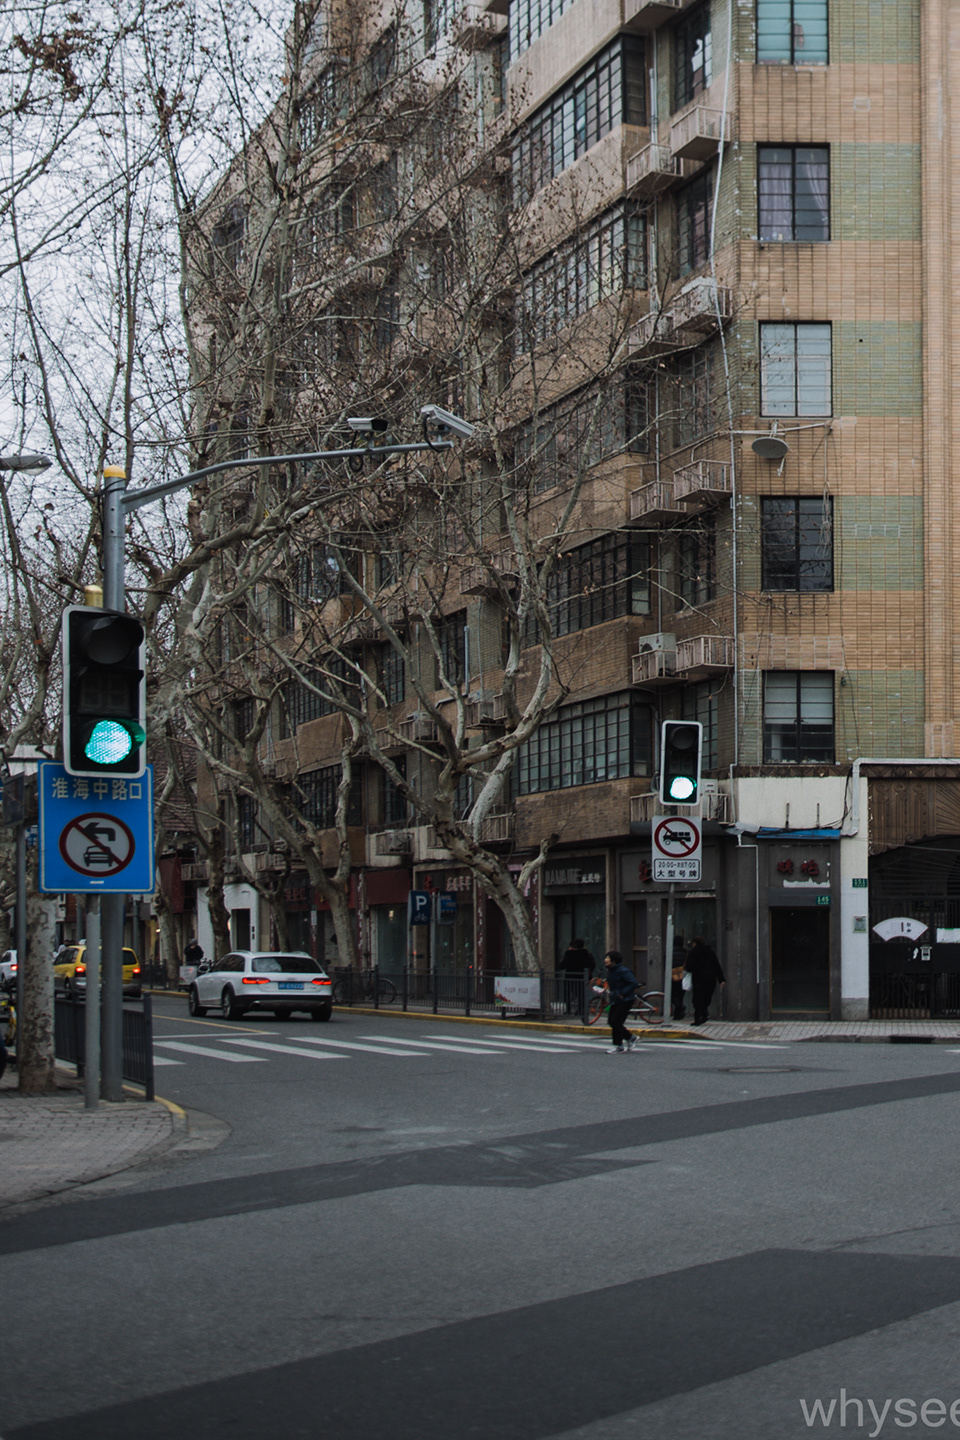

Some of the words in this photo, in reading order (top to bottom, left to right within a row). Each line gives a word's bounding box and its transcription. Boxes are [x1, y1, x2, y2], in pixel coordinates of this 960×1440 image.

[51, 777, 142, 800] 淮海中路口
[657, 869, 697, 878] 大型号牌
[415, 895, 428, 911] P
